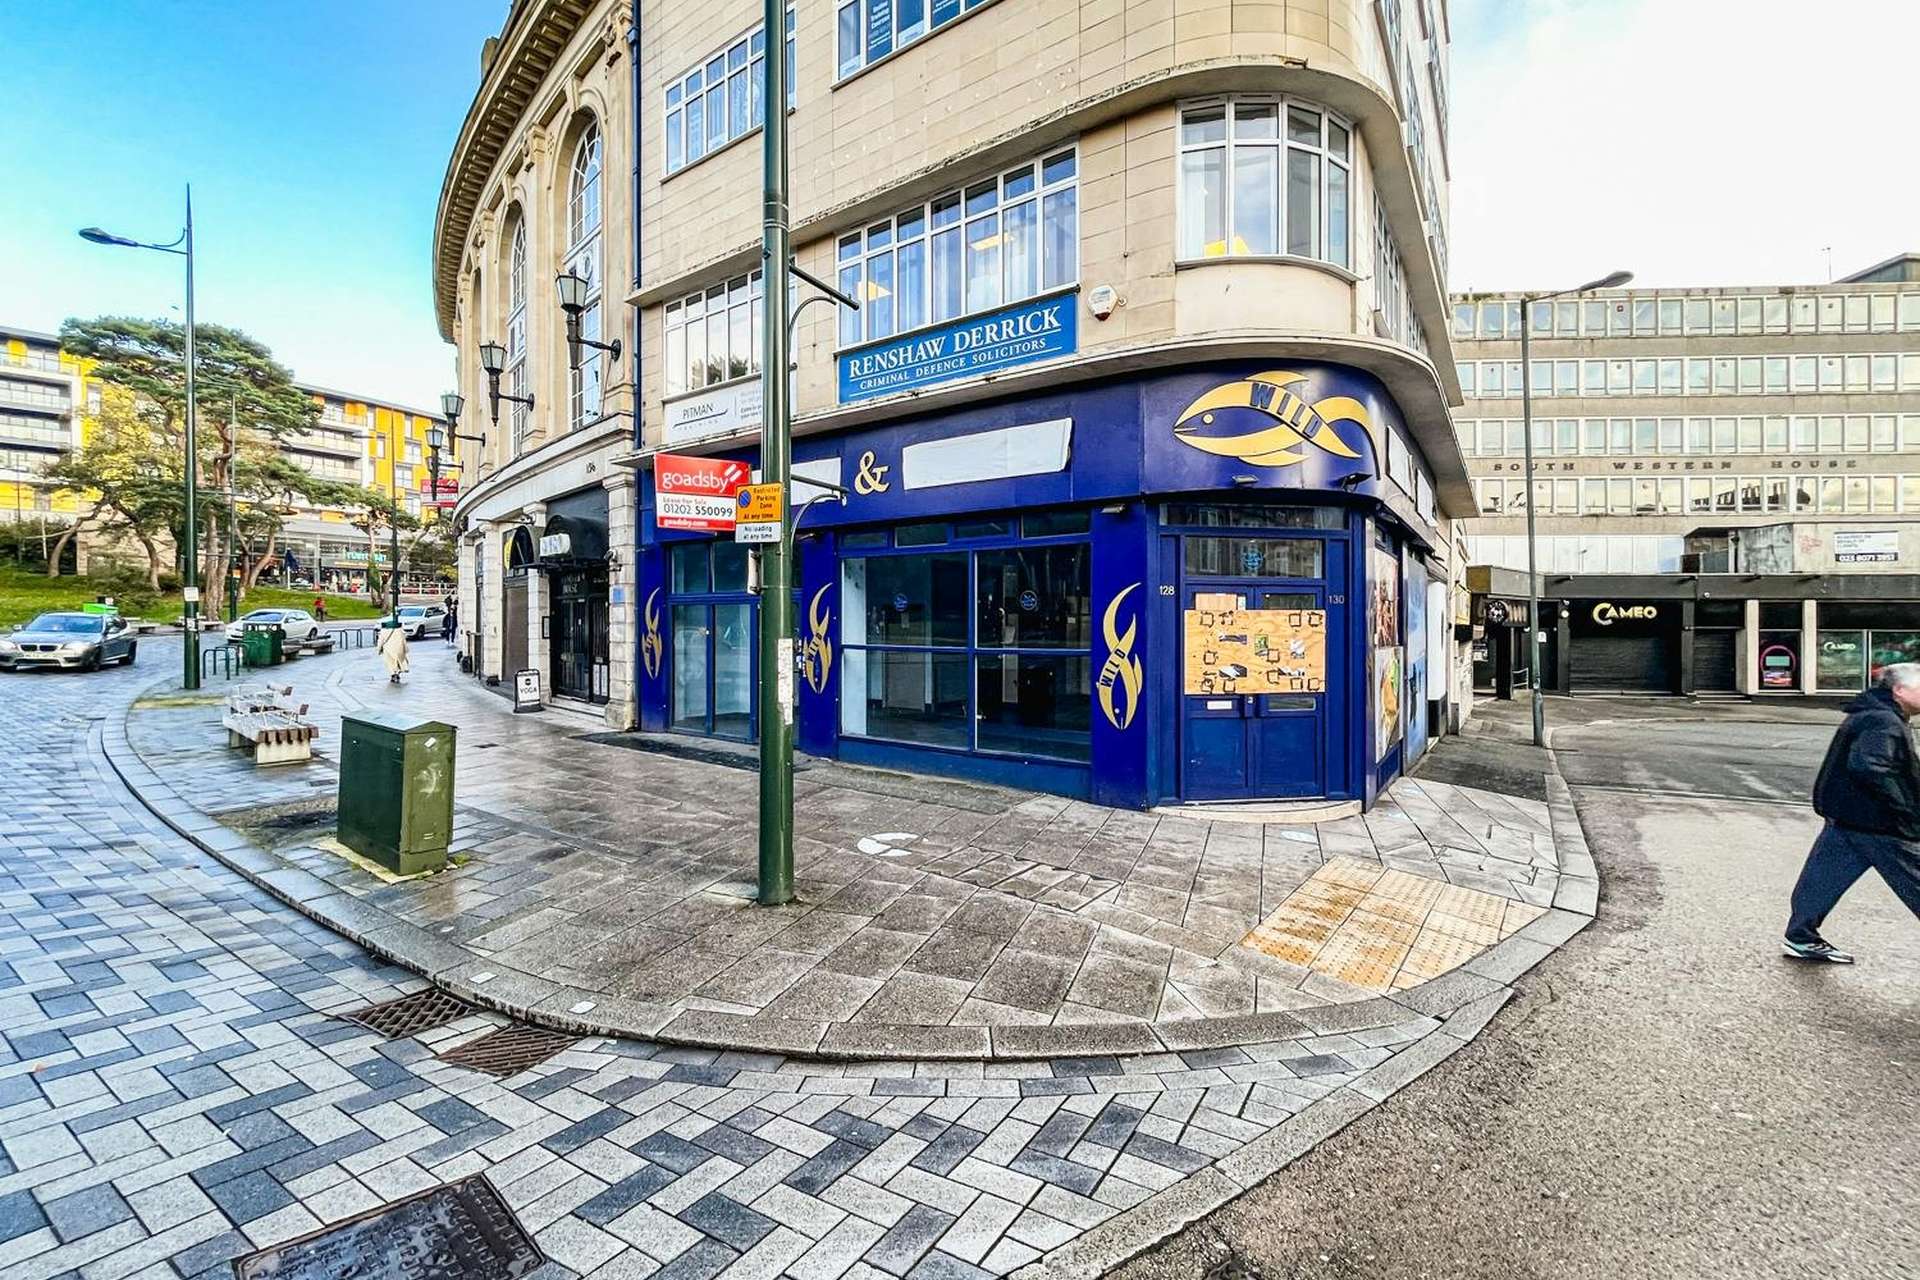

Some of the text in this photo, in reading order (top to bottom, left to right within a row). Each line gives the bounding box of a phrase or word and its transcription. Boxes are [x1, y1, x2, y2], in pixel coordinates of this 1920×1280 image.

[850, 305, 1061, 377] RENSHAW DERRICK
[860, 337, 1046, 390] CRIMINAL DEFENCE SOLICITORS
[682, 403, 713, 420] PITMAN
[1249, 382, 1323, 439] WILD
[854, 450, 890, 495] &
[1494, 460, 1857, 471] SOUTH WESTERN HOUSE
[662, 469, 728, 494] goadsby
[664, 503, 733, 518] 01202 550099
[1159, 585, 1175, 596] 128
[1328, 596, 1345, 605] 130
[1592, 602, 1658, 626] CAMEO
[1100, 648, 1127, 688] WILD
[519, 687, 538, 695] YOGA
